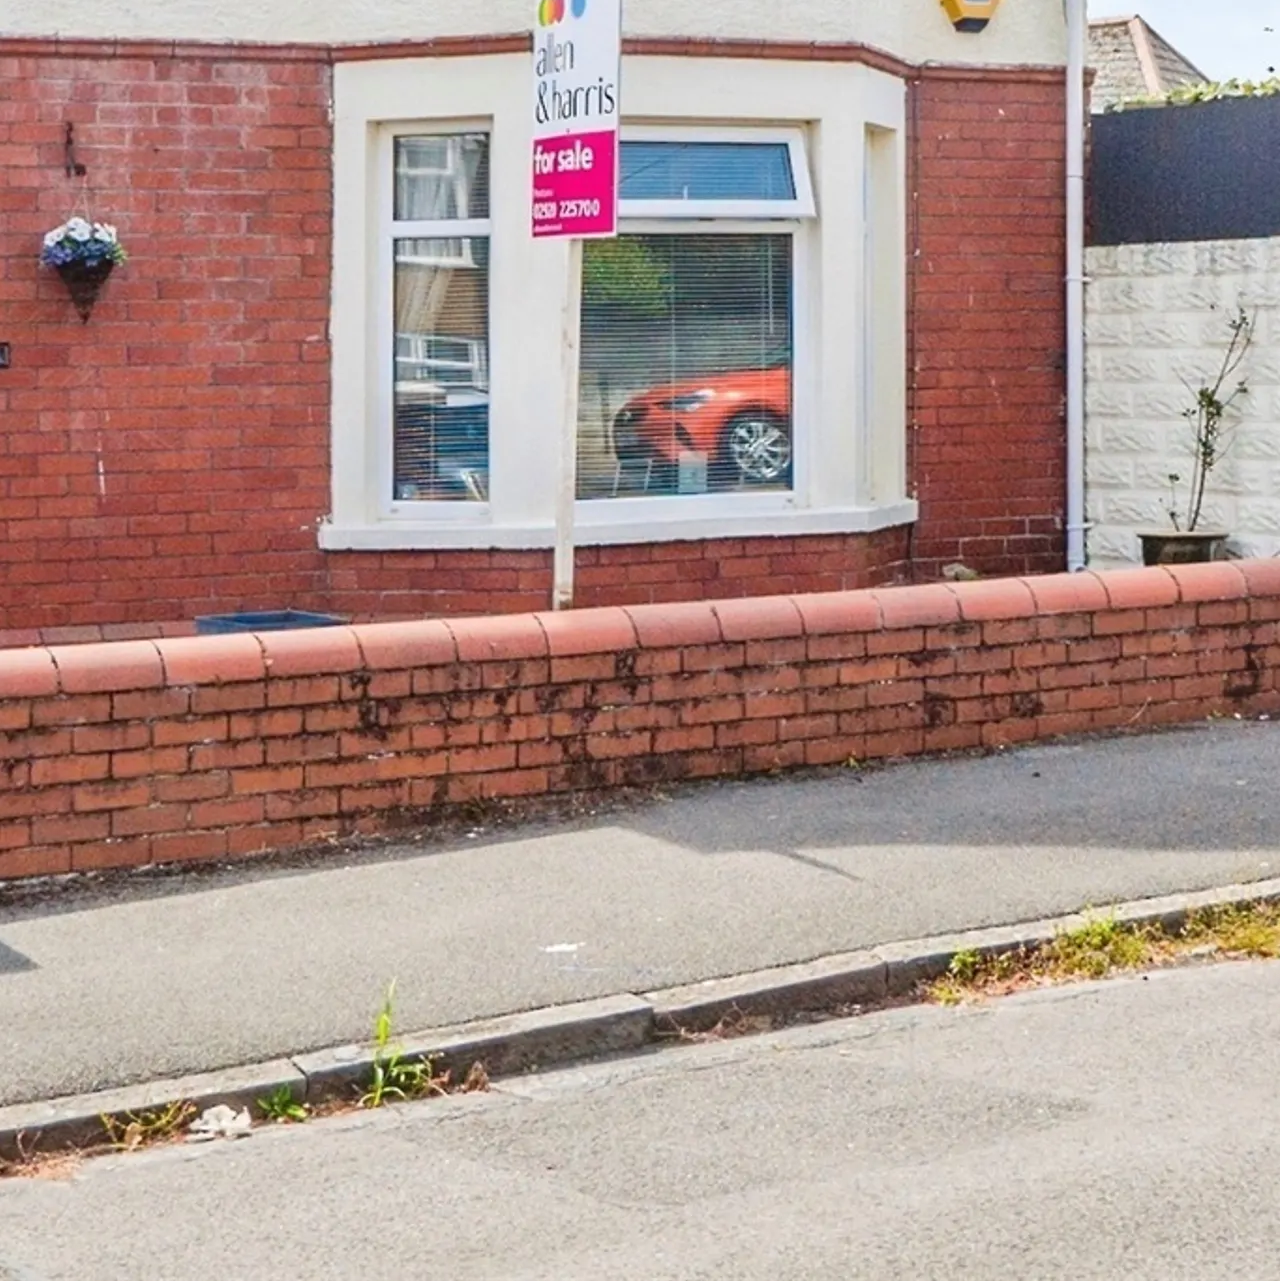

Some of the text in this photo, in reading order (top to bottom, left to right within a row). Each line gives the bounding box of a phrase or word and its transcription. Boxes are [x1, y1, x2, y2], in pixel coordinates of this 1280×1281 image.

[536, 33, 574, 77] allen
[534, 139, 594, 174] for sale
